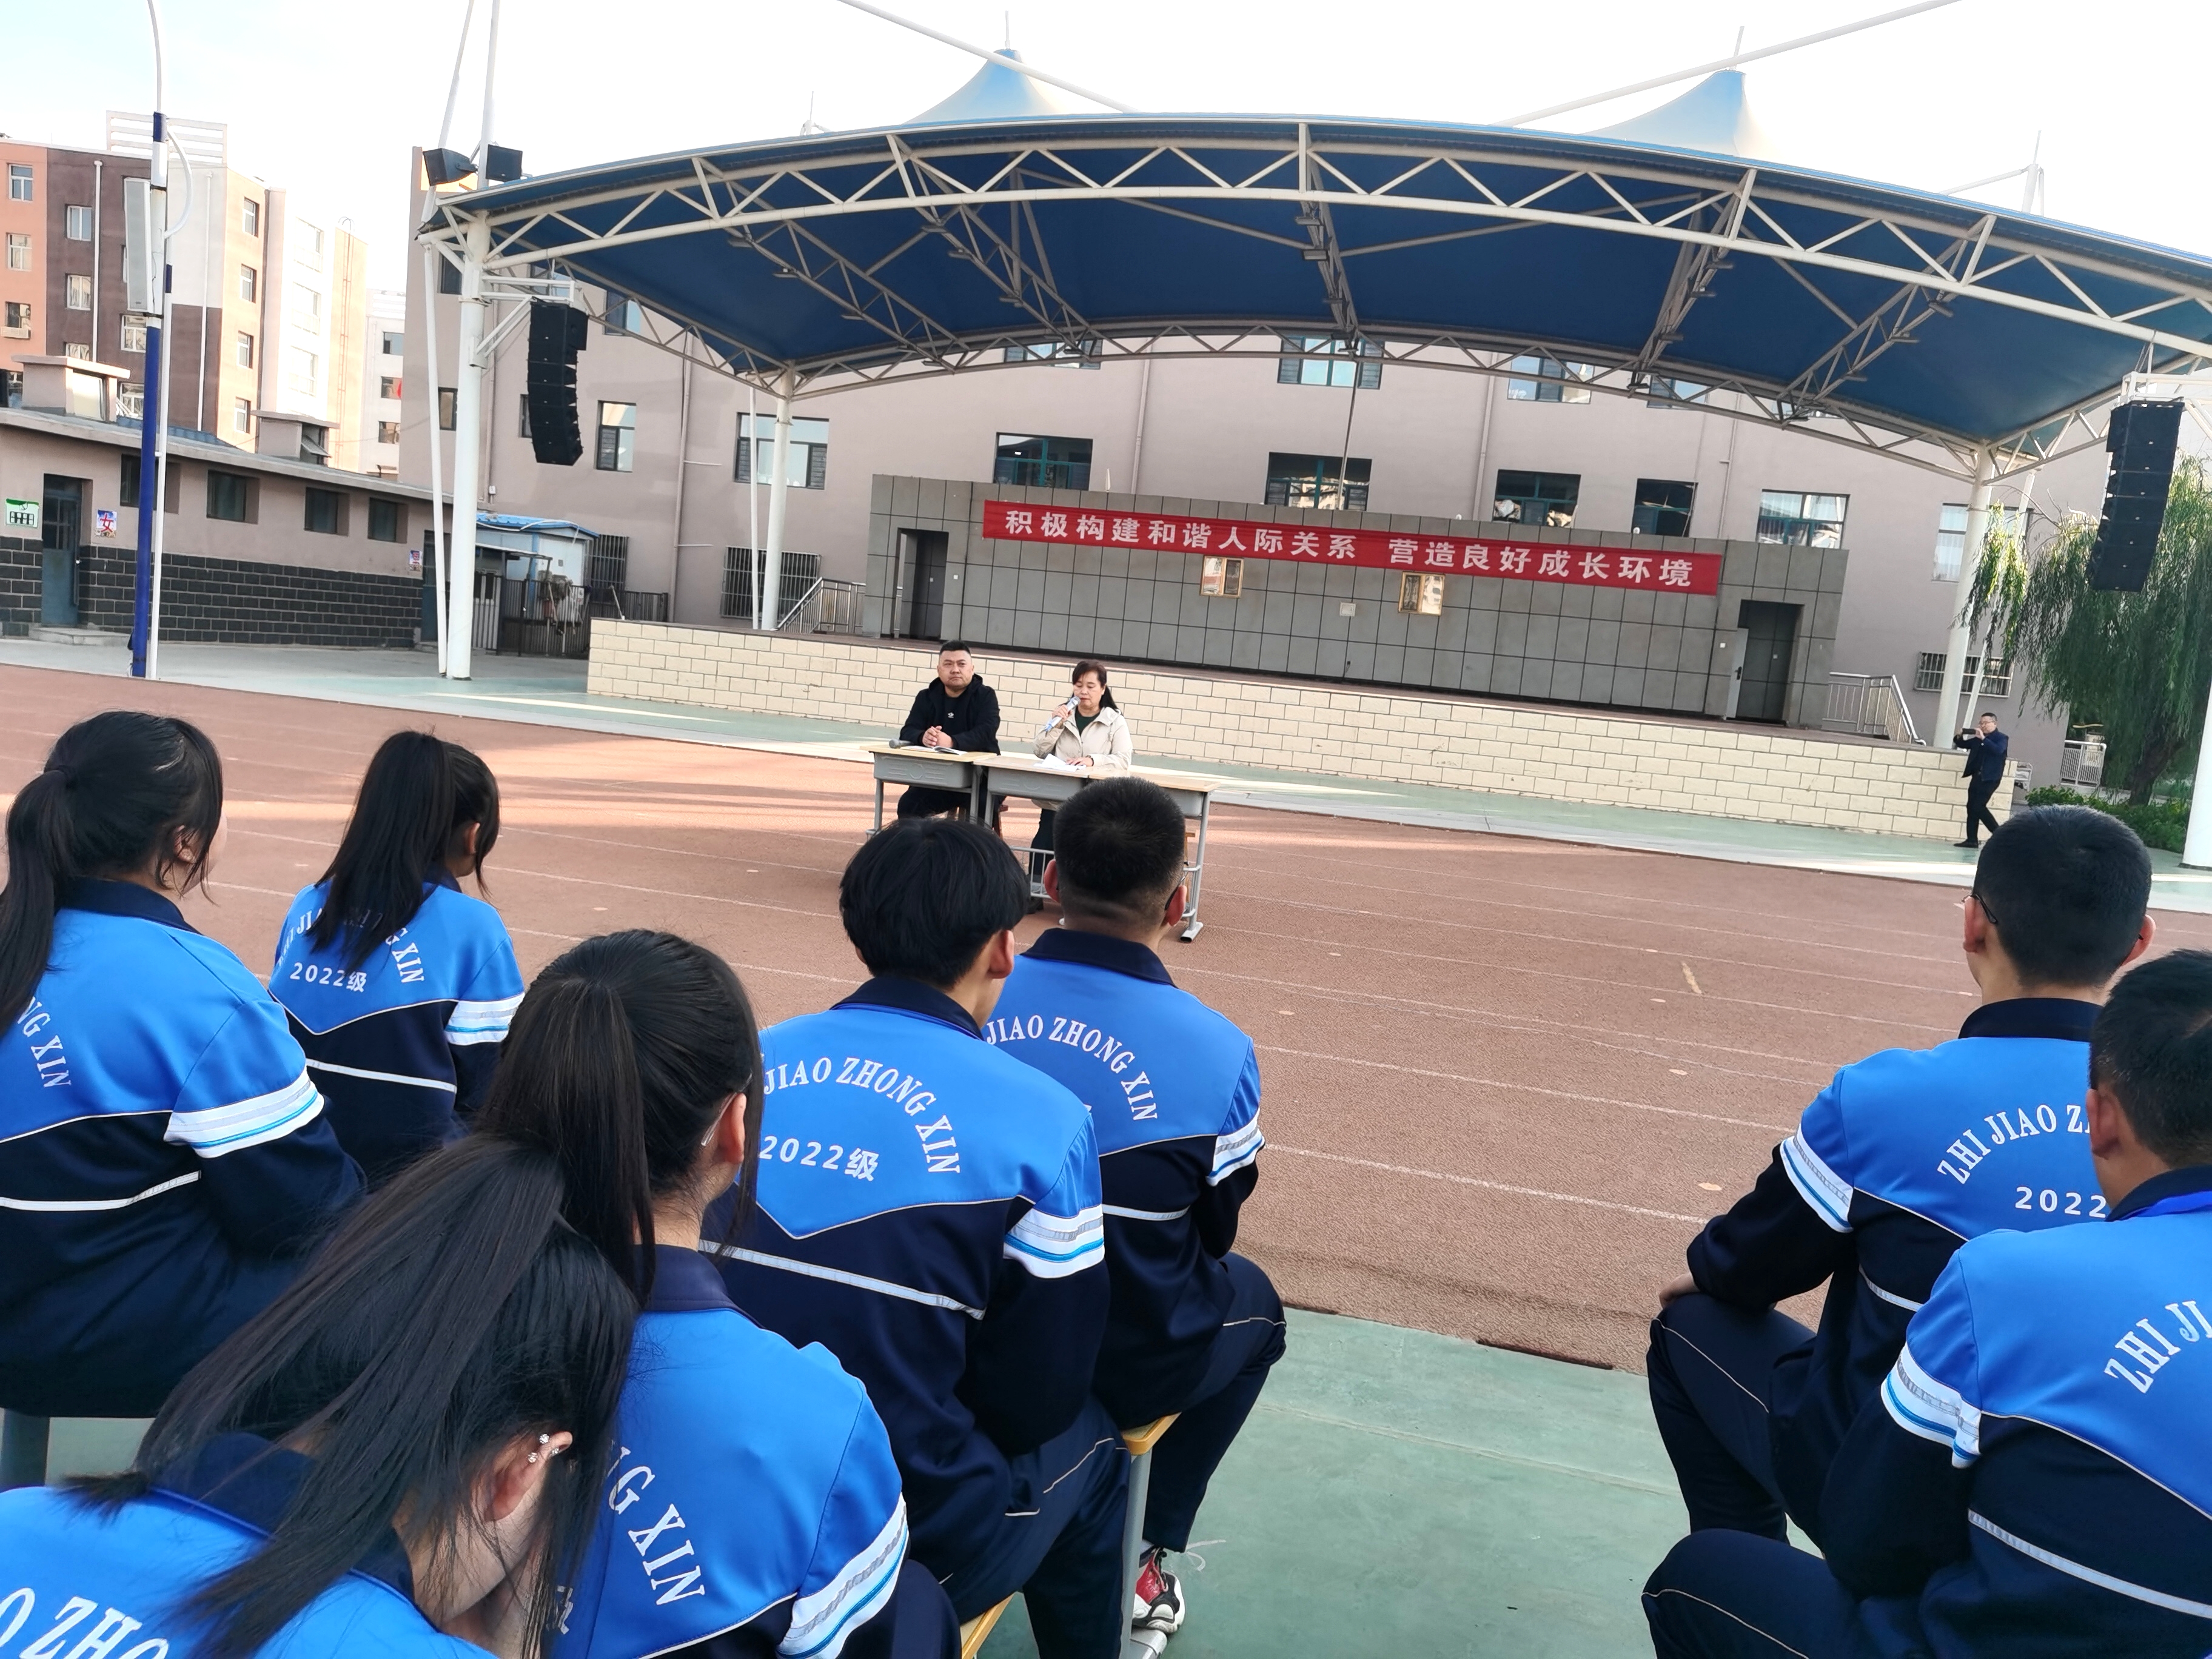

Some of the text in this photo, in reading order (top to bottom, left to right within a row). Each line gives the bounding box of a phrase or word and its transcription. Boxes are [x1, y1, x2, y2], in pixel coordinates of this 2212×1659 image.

[100, 513, 113, 533] 女
[1005, 510, 1694, 587] 积极构建和谐人际关系 营造良好成长环境
[290, 962, 367, 993] 2022级
[392, 942, 424, 983] XIN
[31, 1035, 72, 1087] XIN
[986, 1014, 1158, 1121] JIAO ZHONG XIN
[764, 1057, 960, 1173] JIAO ZHONG XIN
[1937, 1104, 2090, 1184] ZHI JIAO Z
[759, 1136, 879, 1182] 2022级
[2015, 1186, 2107, 1218] 2022
[2103, 1318, 2182, 1394] ZHI
[628, 1503, 705, 1605] XIN
